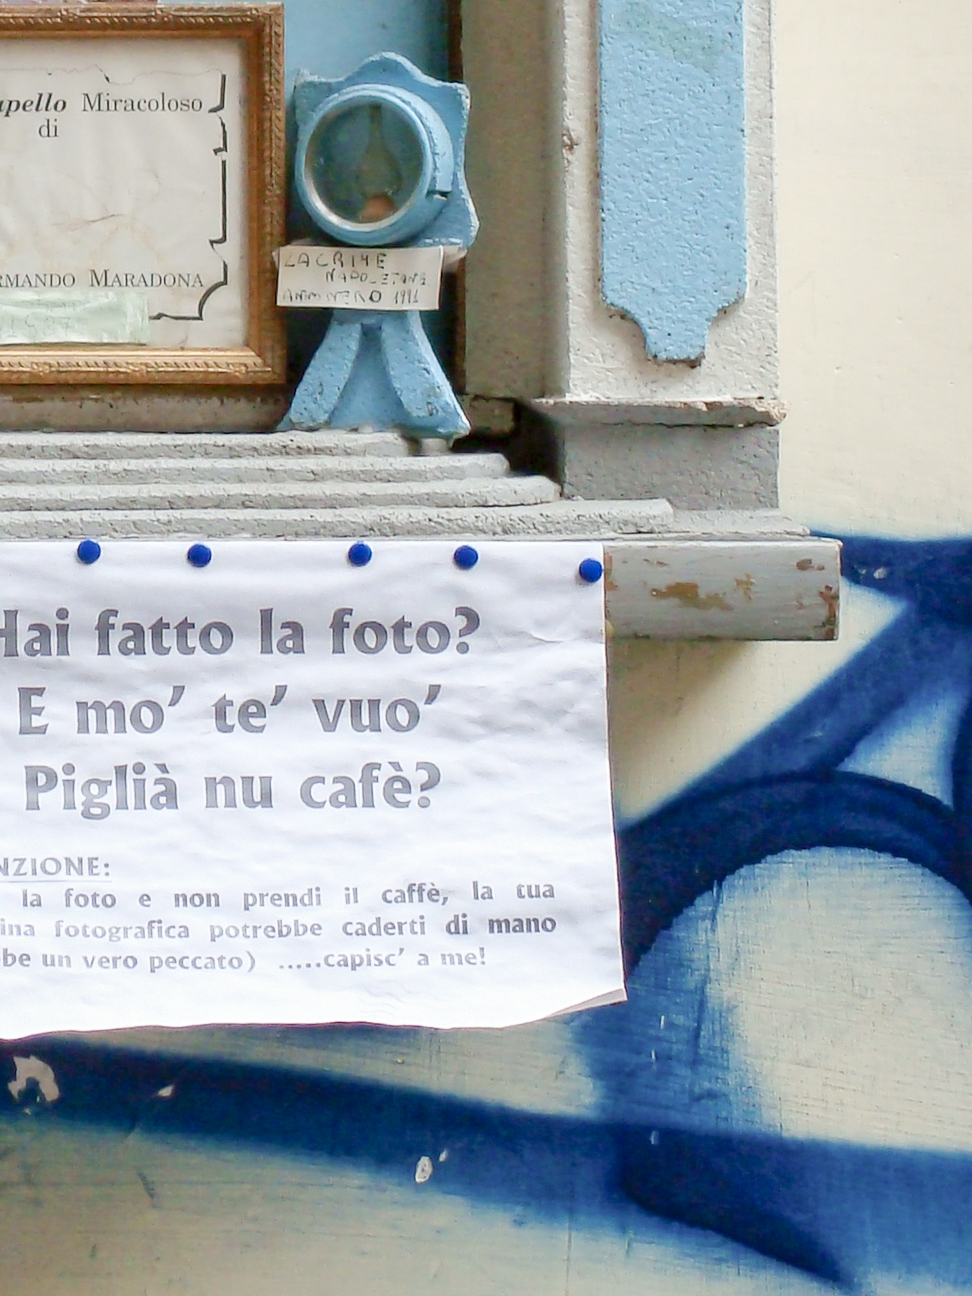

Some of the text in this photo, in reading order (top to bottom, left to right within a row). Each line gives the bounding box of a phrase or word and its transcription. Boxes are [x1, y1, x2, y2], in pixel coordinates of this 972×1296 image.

[81, 91, 203, 113] Miracoloso
[37, 117, 60, 139] di
[88, 269, 204, 288] MARADONA
[94, 608, 234, 657] fatto
[259, 607, 306, 655] la
[328, 606, 481, 655] foto?
[17, 683, 442, 736] E mo' te' vuo'
[24, 761, 441, 821] Piglià nu cafè?
[21, 888, 43, 910] la
[63, 887, 117, 911] foto
[138, 892, 152, 909] e
[173, 891, 223, 911] non
[239, 885, 322, 914] prendi
[343, 886, 359, 906] il
[380, 881, 453, 907] caffè,
[471, 879, 494, 902] la
[515, 883, 556, 900] tua
[54, 918, 191, 943] fotografica
[209, 913, 323, 944] potrebbe
[341, 914, 426, 939] caderti
[444, 911, 472, 939] di
[485, 913, 560, 935] mano
[41, 953, 72, 969] un
[81, 954, 139, 970] vero
[148, 949, 256, 974] peccato)
[278, 946, 405, 973] .....capisc'
[416, 952, 430, 967] a
[439, 946, 486, 966] me!
